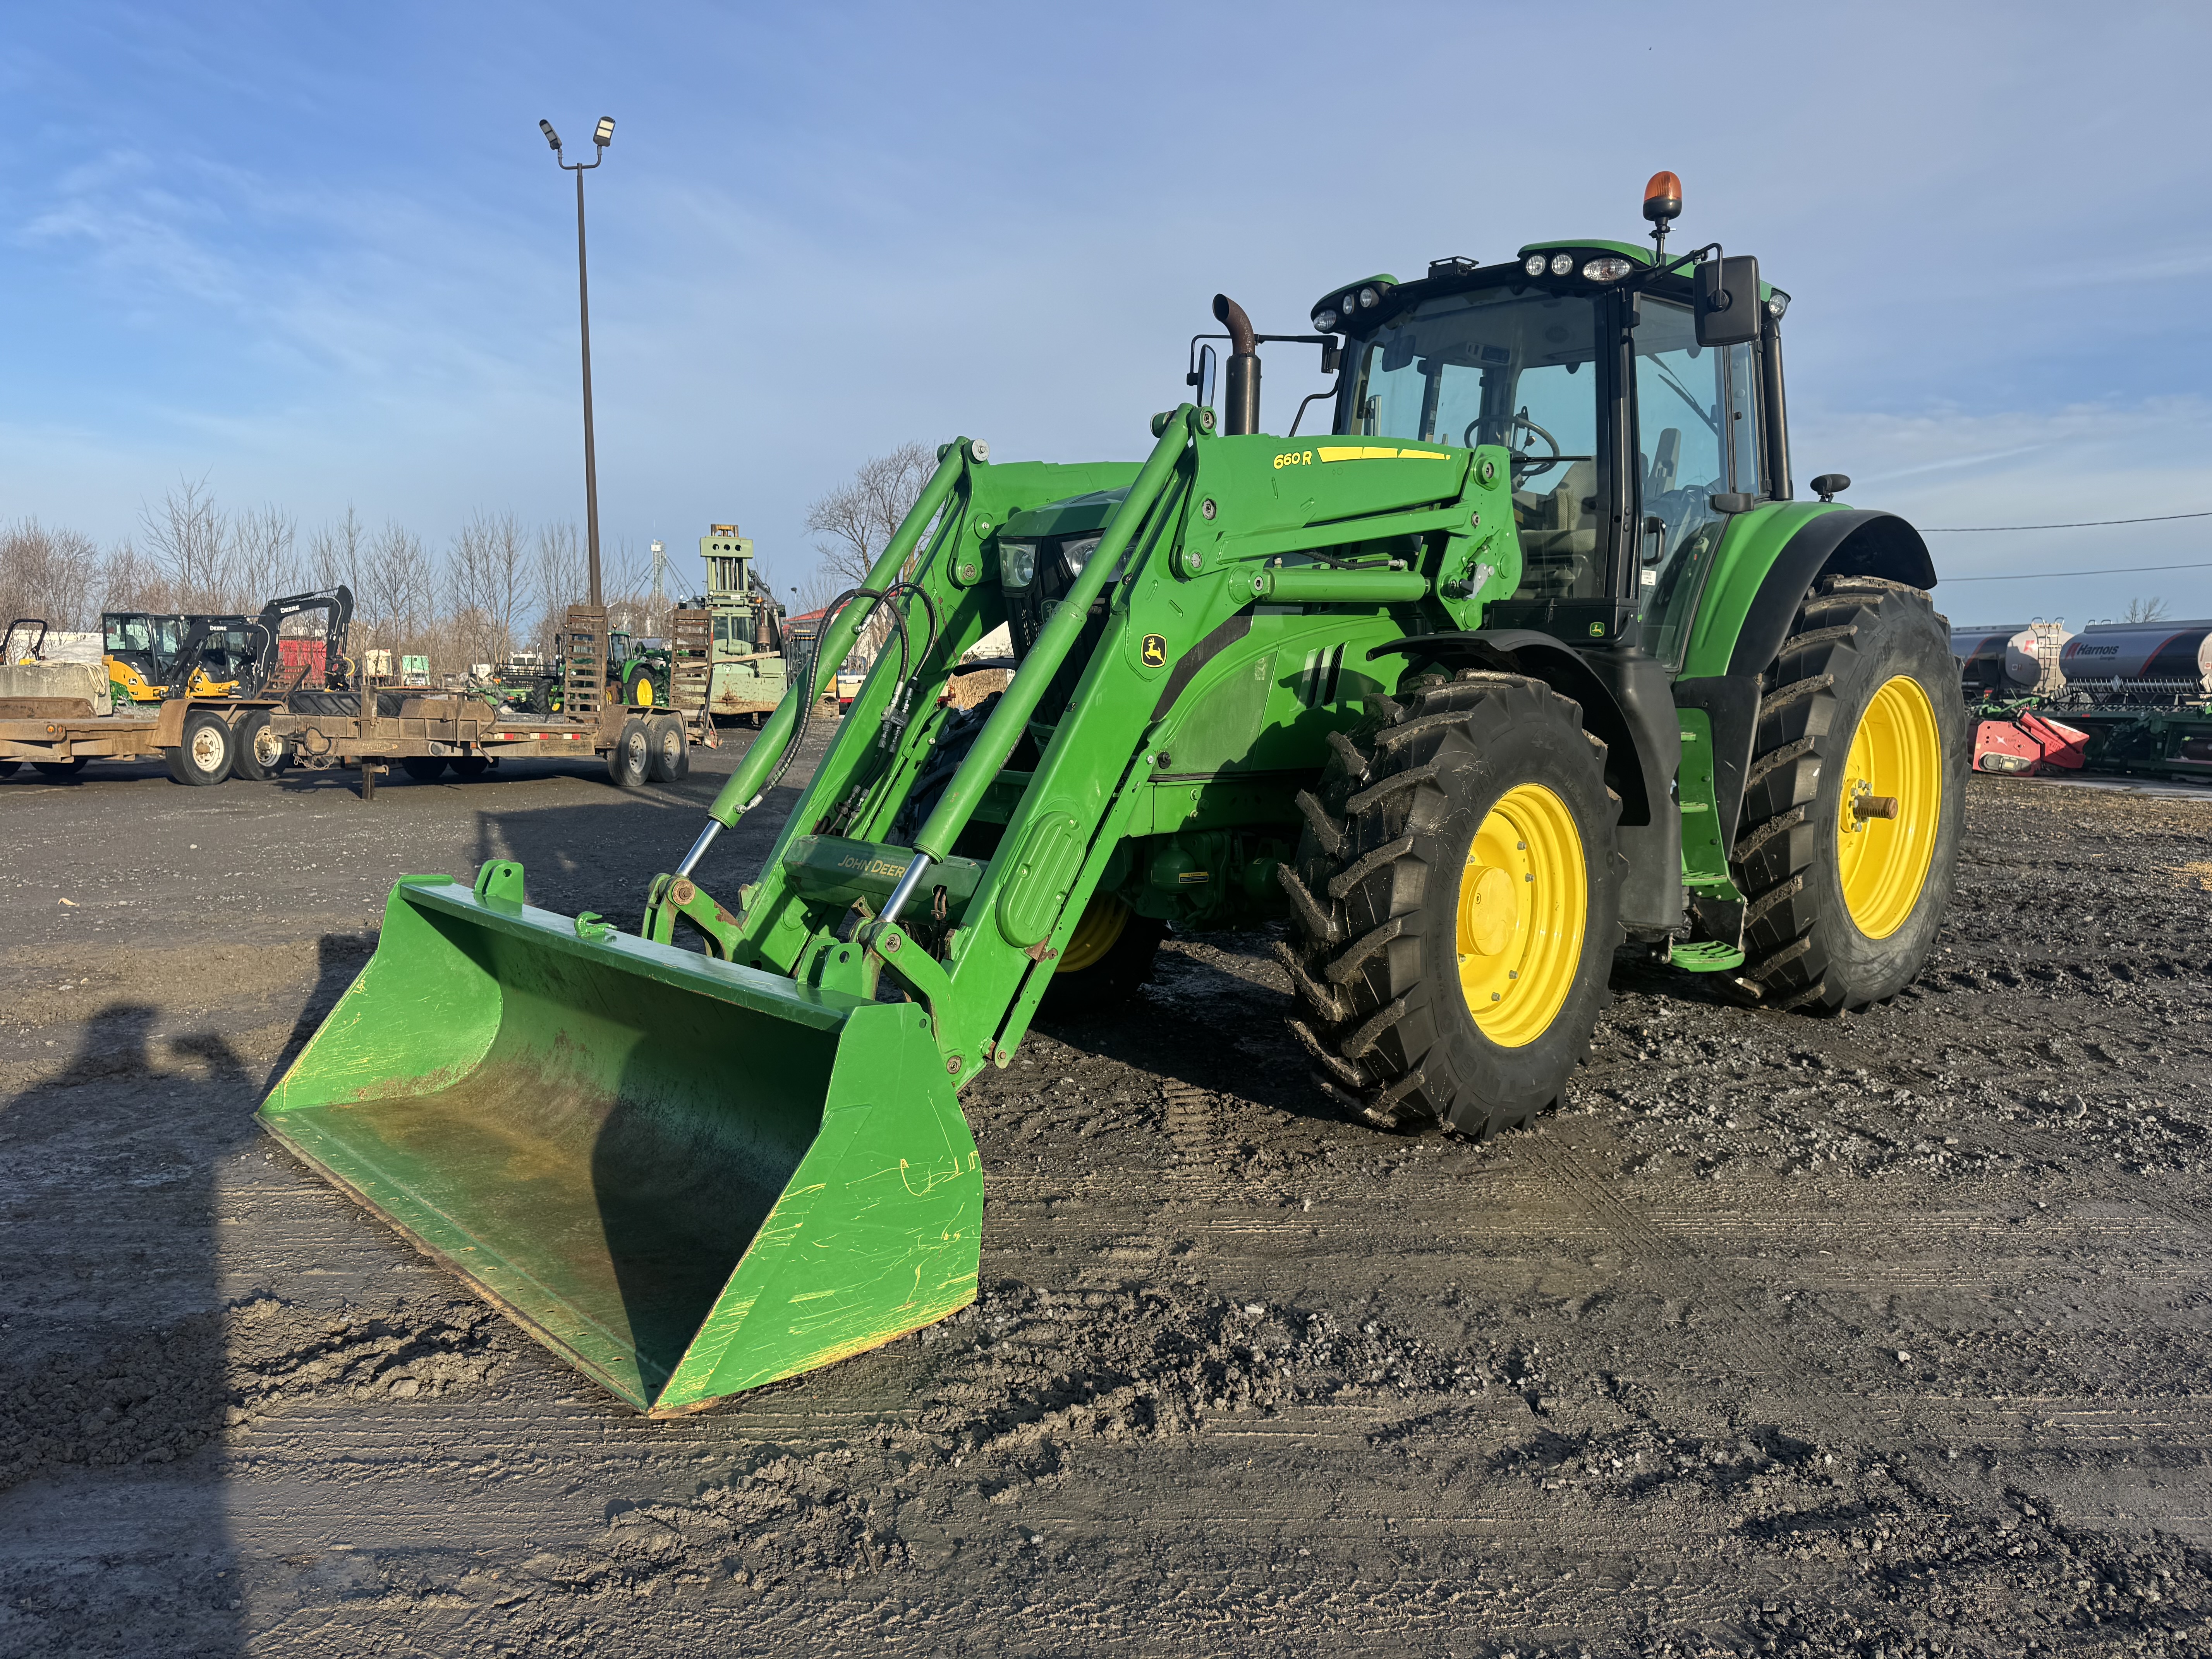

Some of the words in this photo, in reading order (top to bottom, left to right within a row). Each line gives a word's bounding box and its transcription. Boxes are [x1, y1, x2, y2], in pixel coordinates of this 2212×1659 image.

[280, 605, 300, 613] DEERE
[2077, 644, 2119, 655] Harnois
[838, 855, 871, 871] JOHN
[871, 860, 908, 878] DEER
